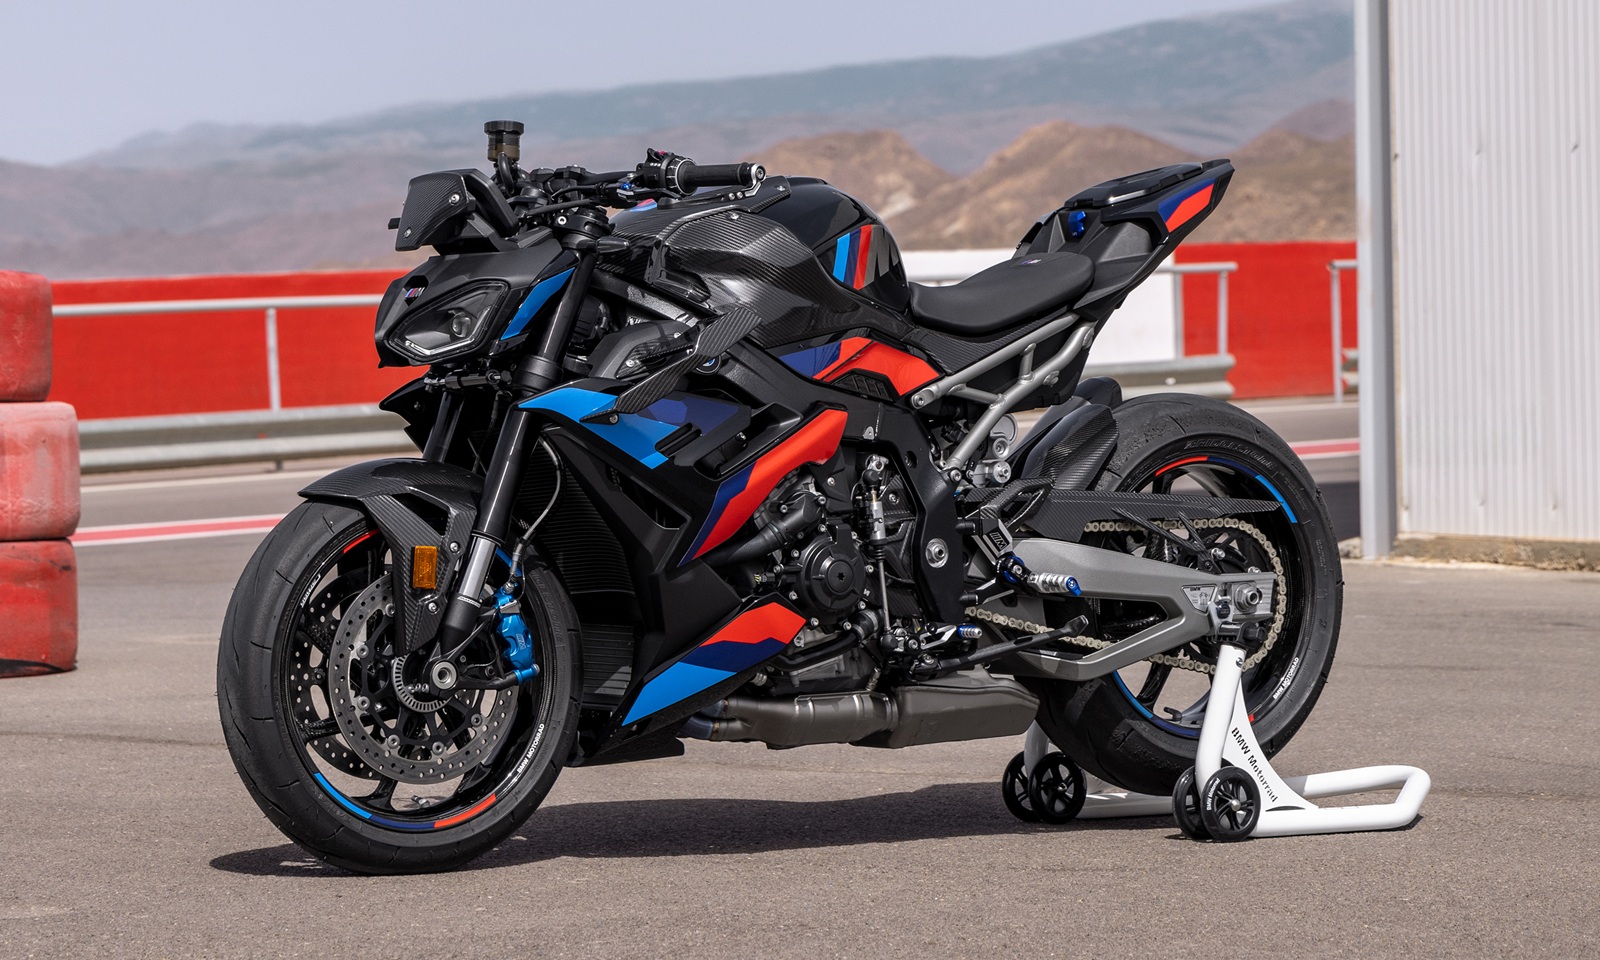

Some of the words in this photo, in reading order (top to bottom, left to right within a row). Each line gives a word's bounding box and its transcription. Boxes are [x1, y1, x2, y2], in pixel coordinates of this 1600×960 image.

[1273, 685, 1284, 700] BMW
[1282, 657, 1299, 687] MOTORRAD
[517, 757, 529, 773] BMW
[526, 723, 545, 759] MOTORRAD
[1231, 727, 1251, 755] BMW
[1247, 755, 1278, 802] Motorrad
